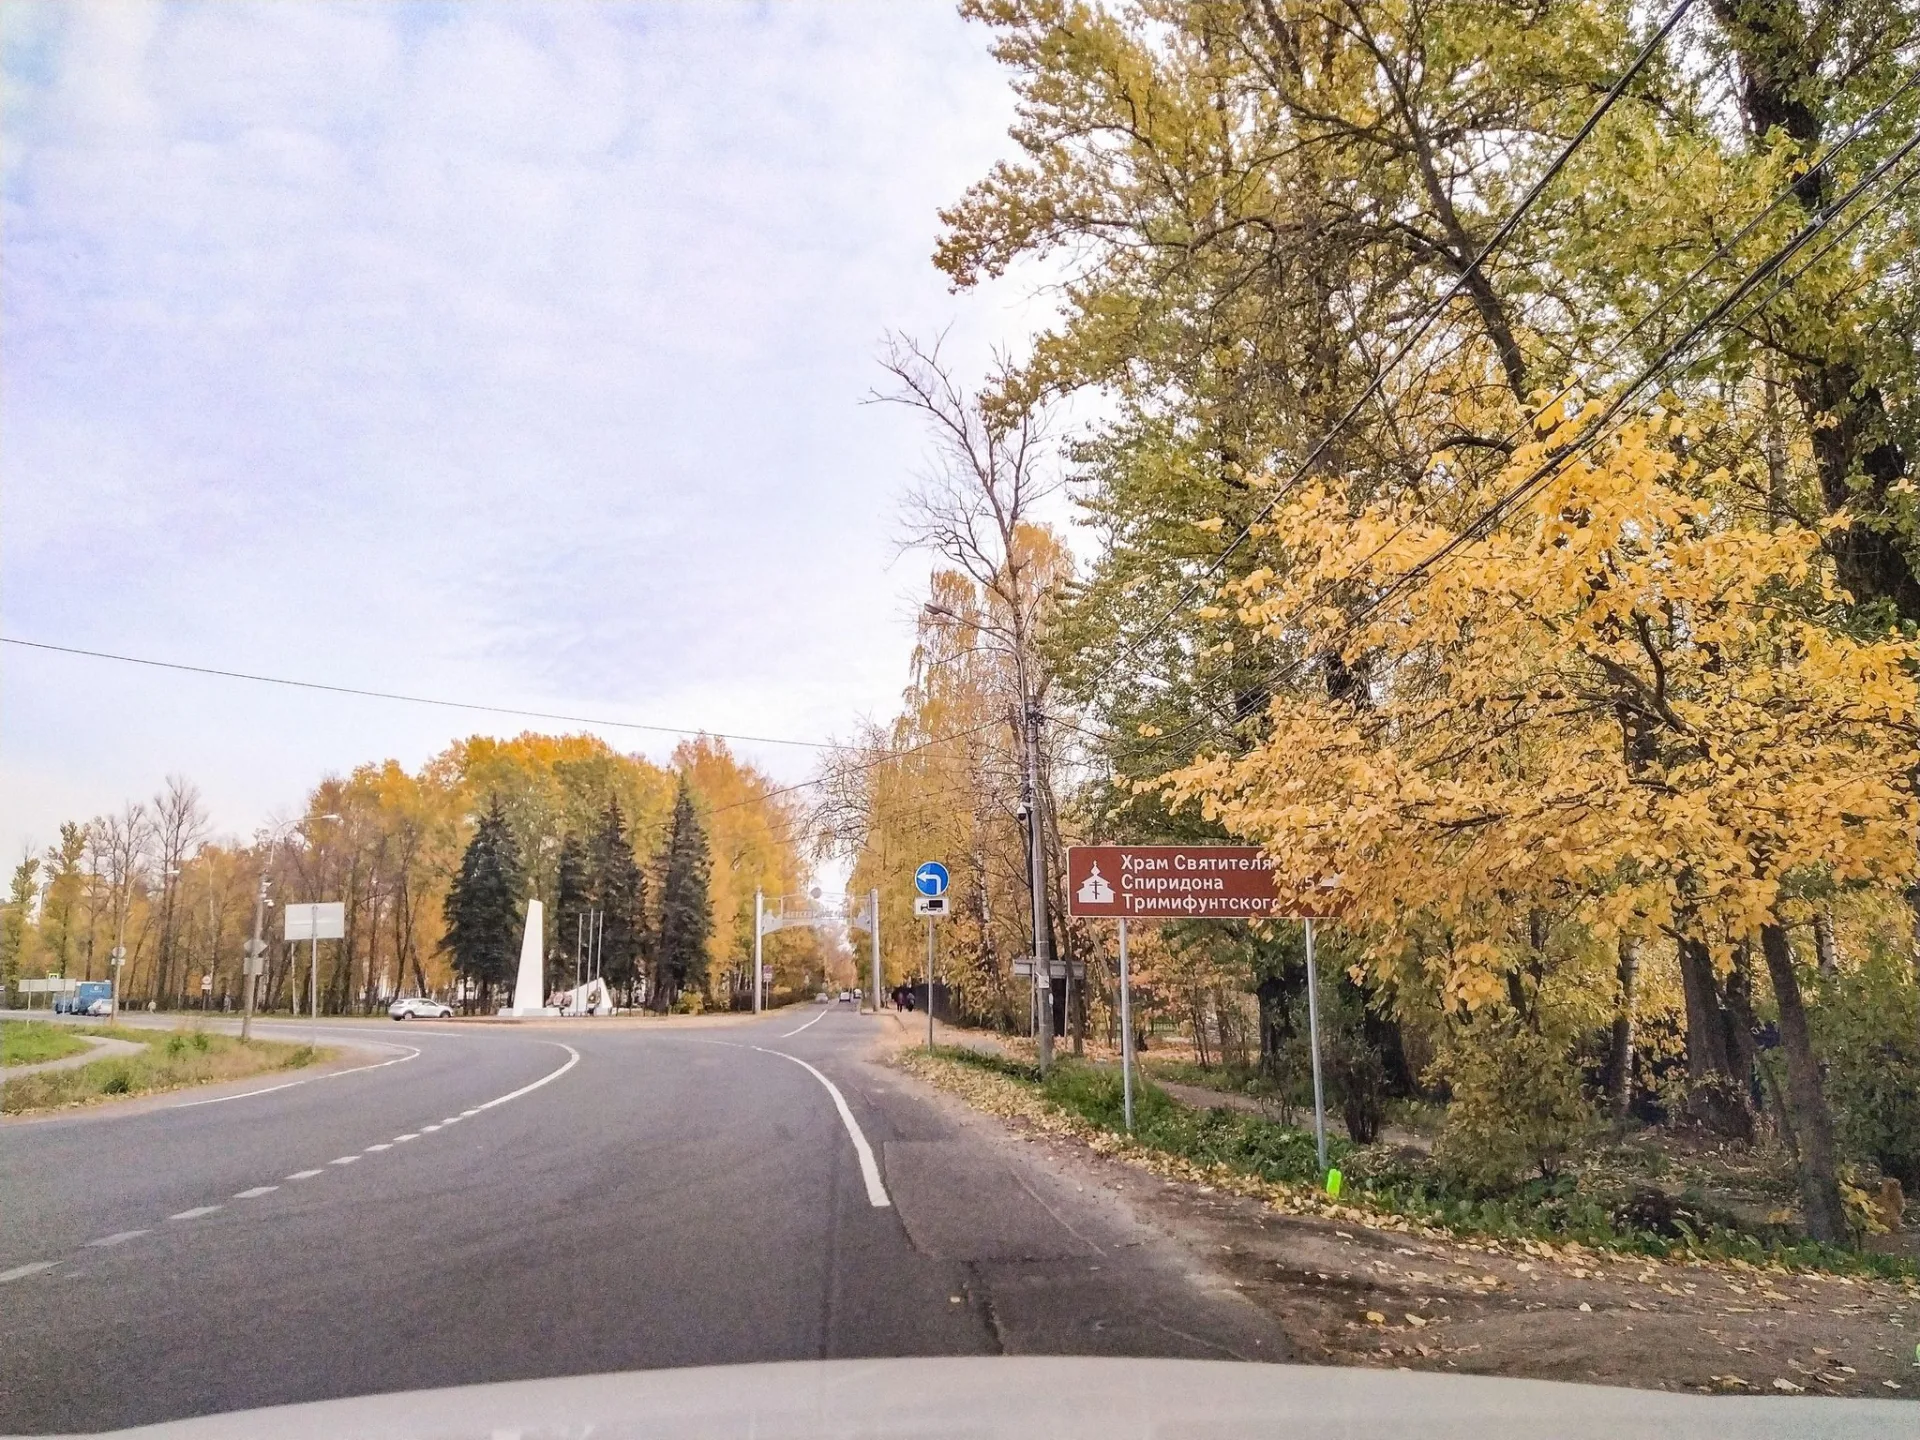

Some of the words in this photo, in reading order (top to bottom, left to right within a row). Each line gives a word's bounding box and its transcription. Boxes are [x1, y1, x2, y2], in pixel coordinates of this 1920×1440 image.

[1121, 854, 1169, 874] Храм
[1174, 854, 1272, 871] Святителя
[1121, 873, 1224, 893] Спиридона
